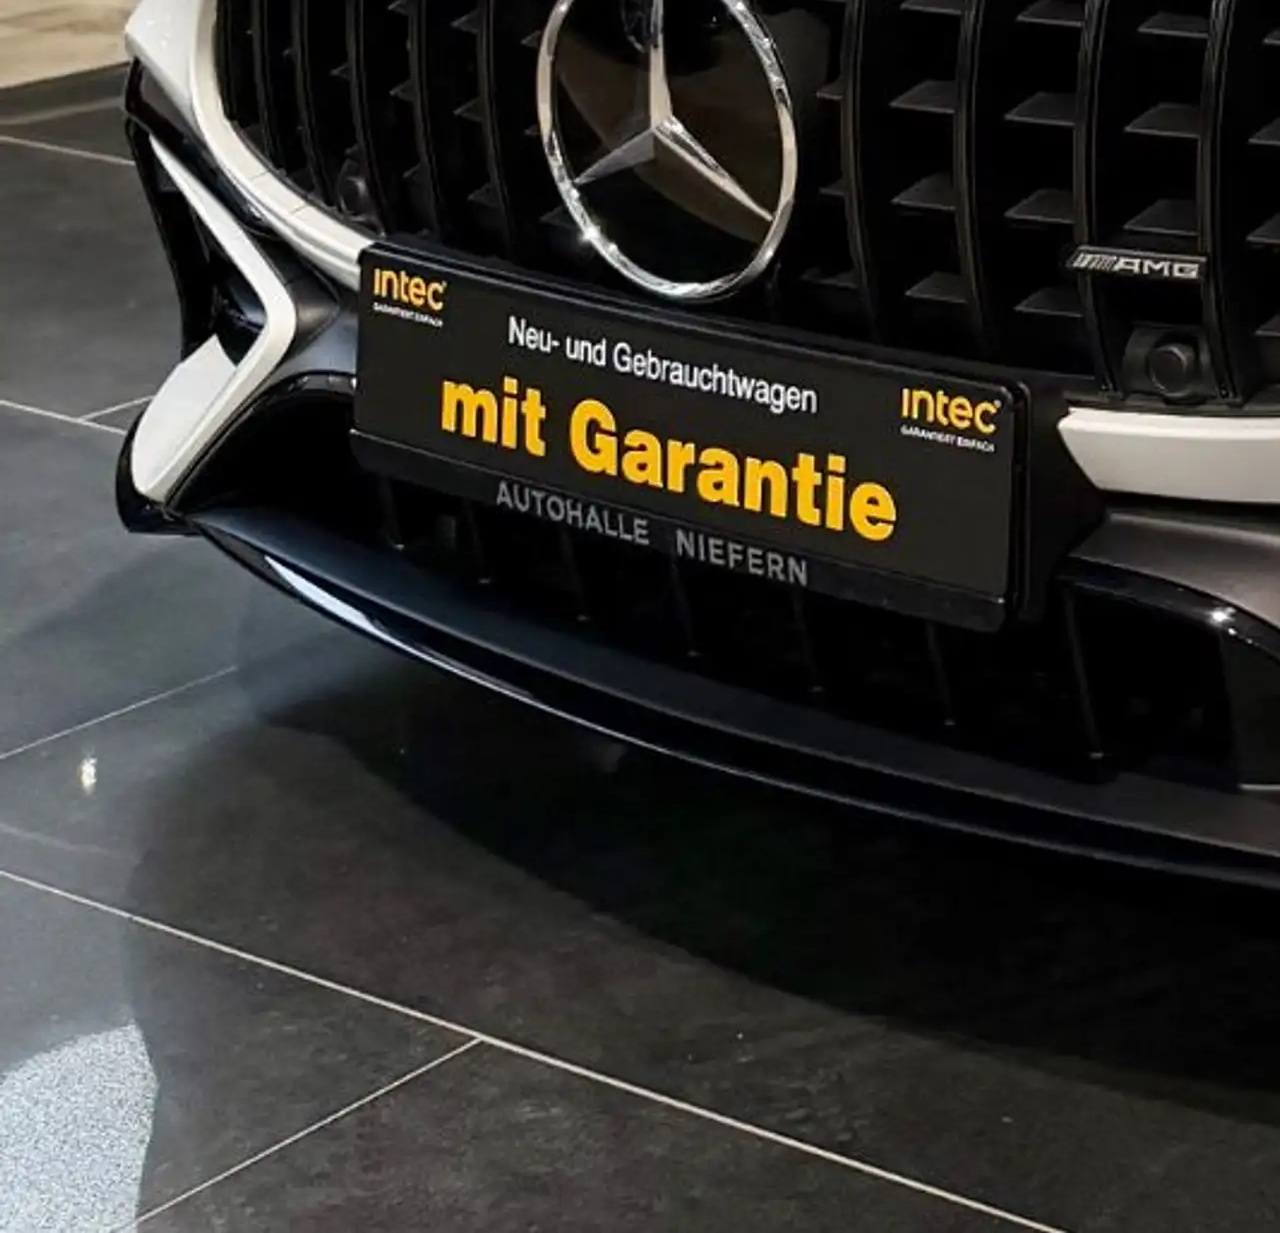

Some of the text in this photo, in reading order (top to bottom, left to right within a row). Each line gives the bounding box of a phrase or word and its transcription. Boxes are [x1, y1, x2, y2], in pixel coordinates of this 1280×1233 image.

[374, 268, 445, 311] intec
[1113, 256, 1199, 279] AMG
[508, 315, 818, 415] Neu- und Gebrauchtwagen
[901, 388, 998, 434] intec
[441, 377, 898, 542] mit Garantie
[496, 480, 808, 586] AUTOHALLE NIEFERN
